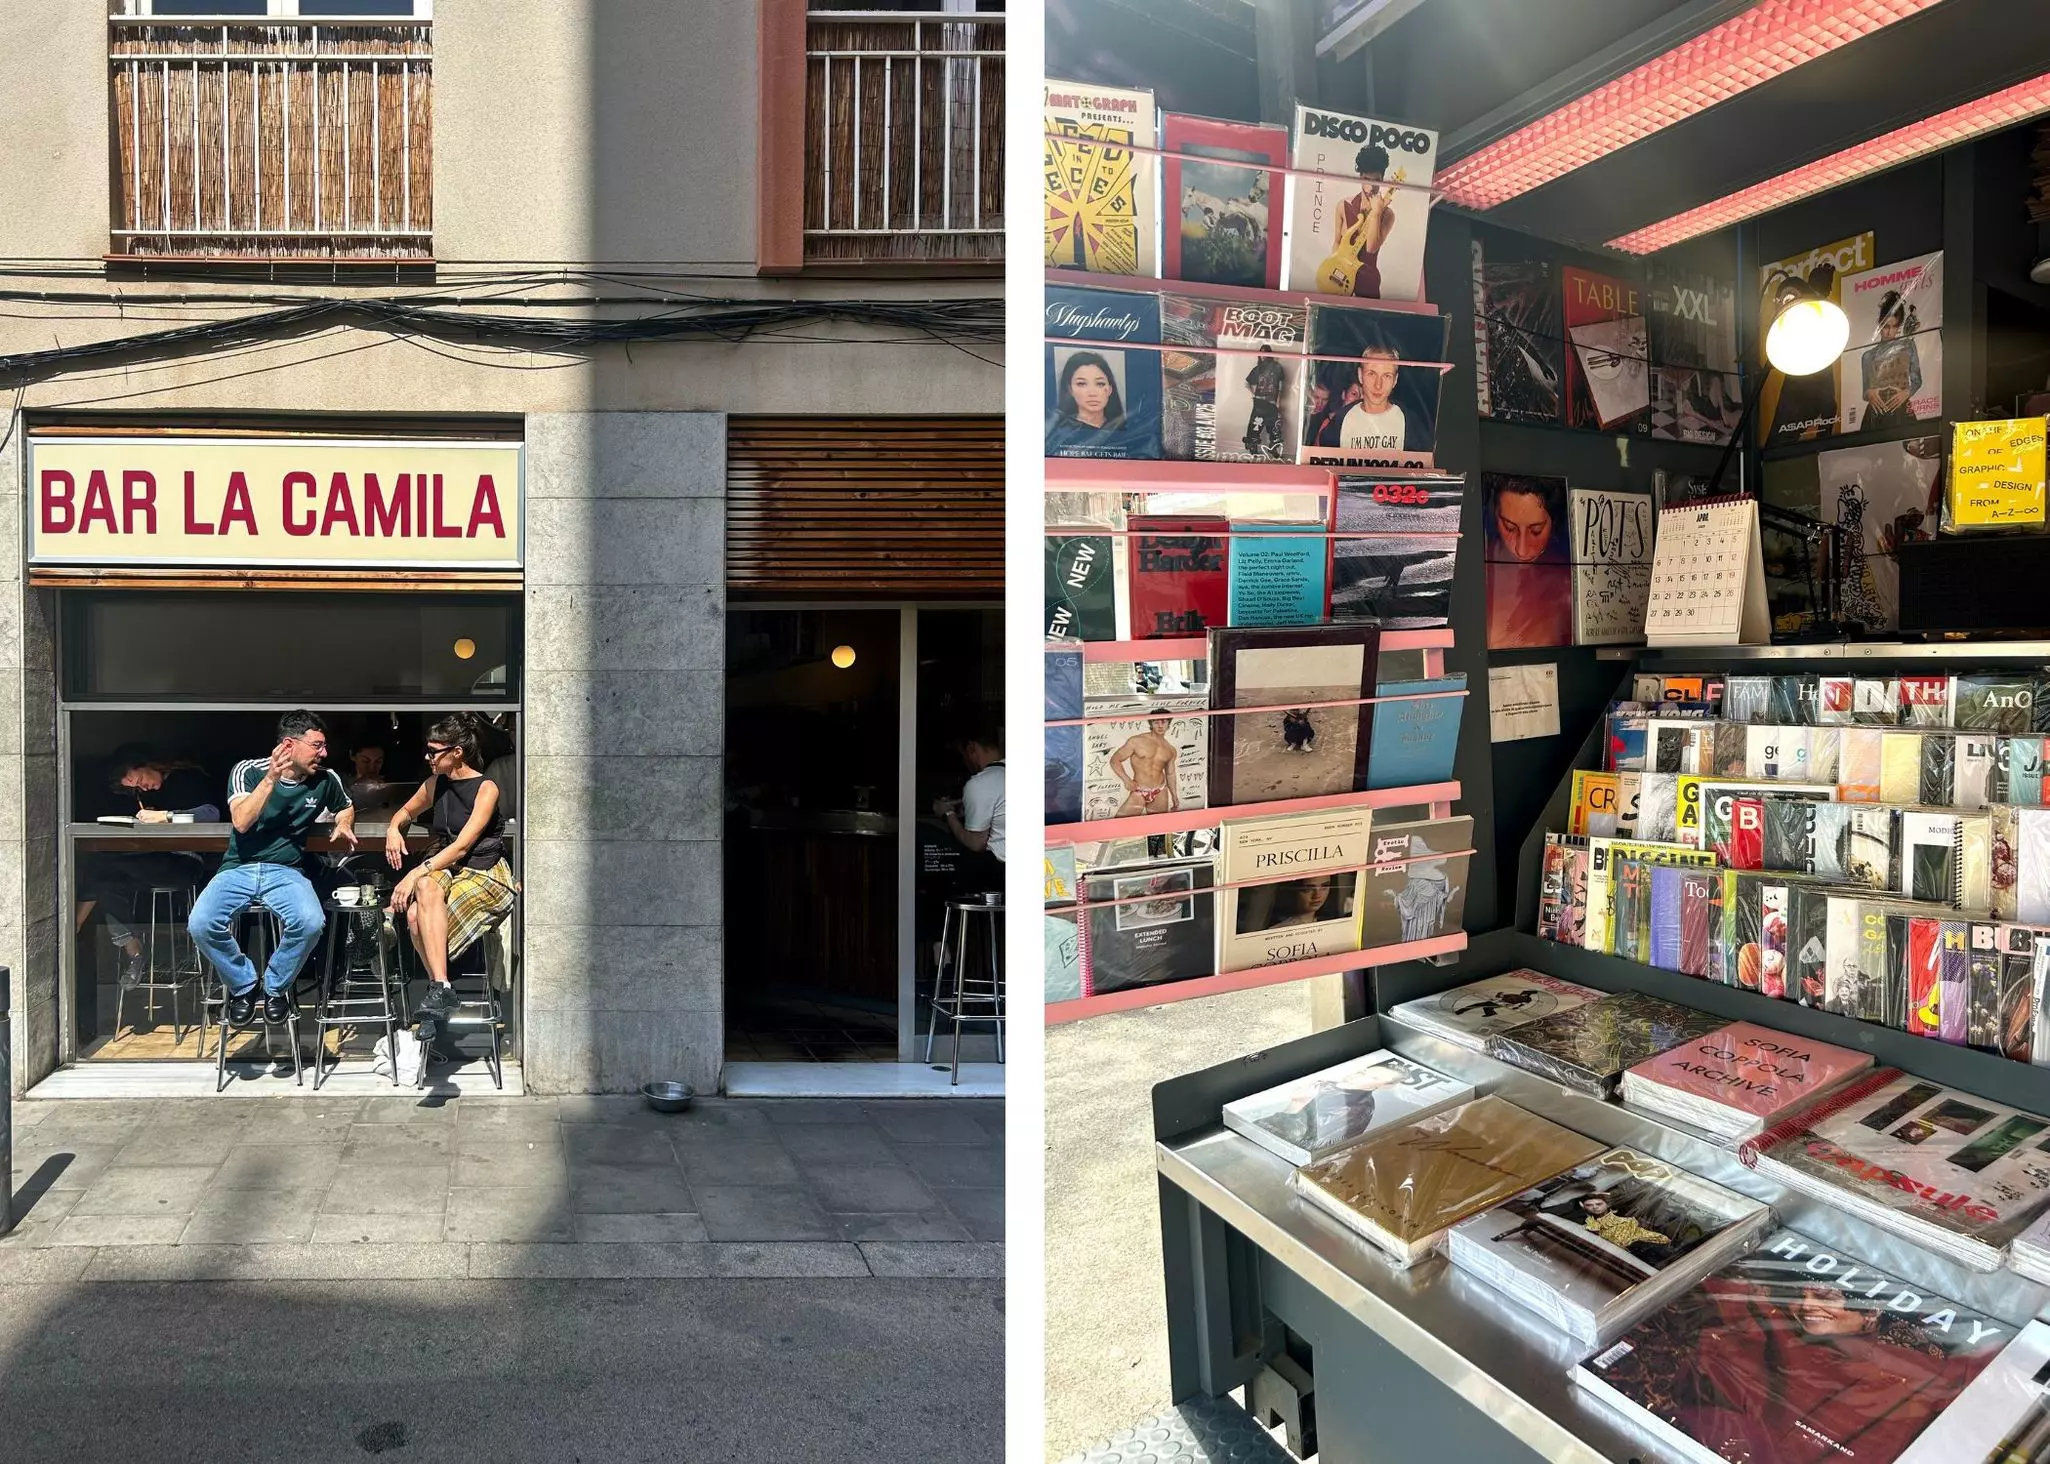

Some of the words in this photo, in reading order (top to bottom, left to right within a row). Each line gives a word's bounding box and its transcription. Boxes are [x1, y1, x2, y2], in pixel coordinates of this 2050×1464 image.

[1304, 112, 1367, 143] DISCO
[1369, 124, 1430, 154] POGO
[1854, 266, 1924, 293] HOMME
[1572, 277, 1639, 315] TABLE
[1672, 284, 1717, 326] XXL
[1225, 308, 1293, 327] BOOT
[1222, 323, 1295, 346] MAG
[1350, 437, 1363, 449] I'M
[1363, 437, 1379, 449] NOT
[1381, 436, 1398, 448] GAY
[2010, 435, 2044, 448] EDGES
[1959, 464, 2005, 474] GRAPHIC
[1373, 484, 1429, 505] 032c
[1993, 480, 2032, 491] DESIGN
[41, 470, 157, 534] BAR
[184, 471, 259, 535] LA
[282, 472, 506, 539] CAMILA
[1970, 499, 1999, 507] FROM
[1583, 497, 1647, 558] POTS
[1067, 543, 1095, 588] NEW
[1055, 657, 1078, 668] 05
[1256, 845, 1344, 868] PRISCILLA
[1135, 928, 1168, 939] EXTENDED
[1139, 935, 1163, 944] LUNCH
[1266, 942, 1318, 961] SOFIA
[1743, 1038, 1812, 1063] SOFIA
[1699, 1045, 1807, 1083] COPPOLA
[1671, 1061, 1781, 1097] ARCHIVE
[1770, 1237, 2002, 1345] HOLIDAY
[1795, 1420, 1855, 1457] SAMARKAND
